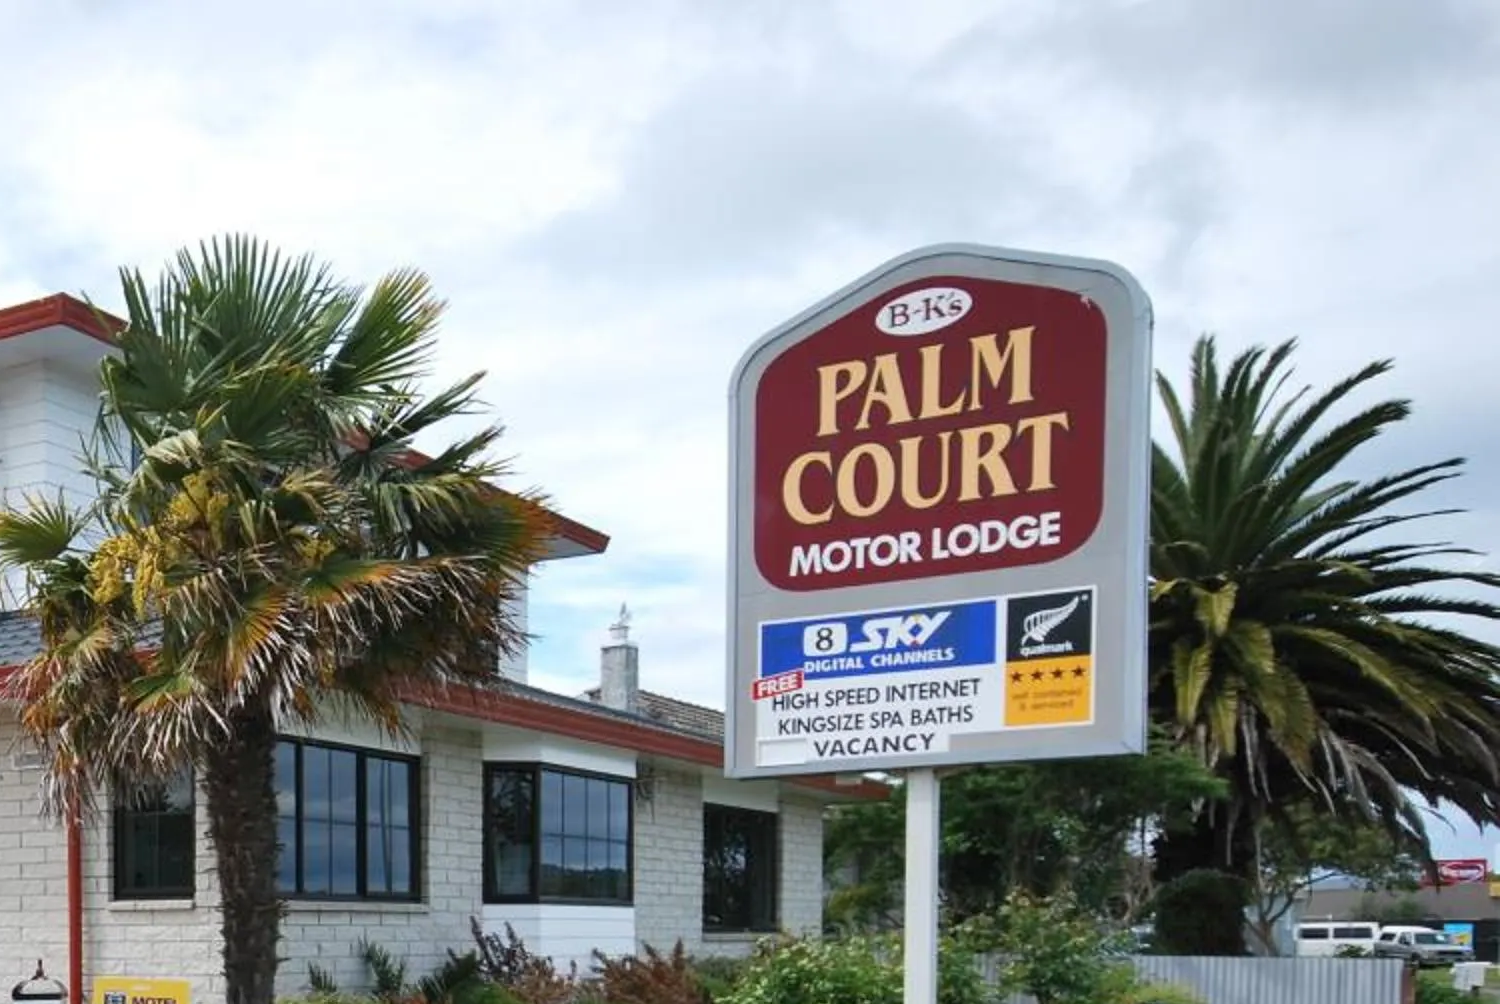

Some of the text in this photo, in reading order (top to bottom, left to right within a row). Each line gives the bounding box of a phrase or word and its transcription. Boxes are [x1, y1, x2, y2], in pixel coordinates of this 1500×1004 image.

[816, 325, 1036, 437] PALM
[782, 411, 1070, 525] COURT
[789, 511, 1061, 577] MOTOR LODGE
[815, 611, 952, 652] 8 SKY
[804, 647, 955, 673] DIGITAL CHANNELS
[757, 674, 799, 697] FREE
[772, 678, 982, 711] HIGH SPEED INTERNET
[778, 705, 974, 736] KINGSIZE SPA BATHS
[814, 733, 936, 757] VACANCY
